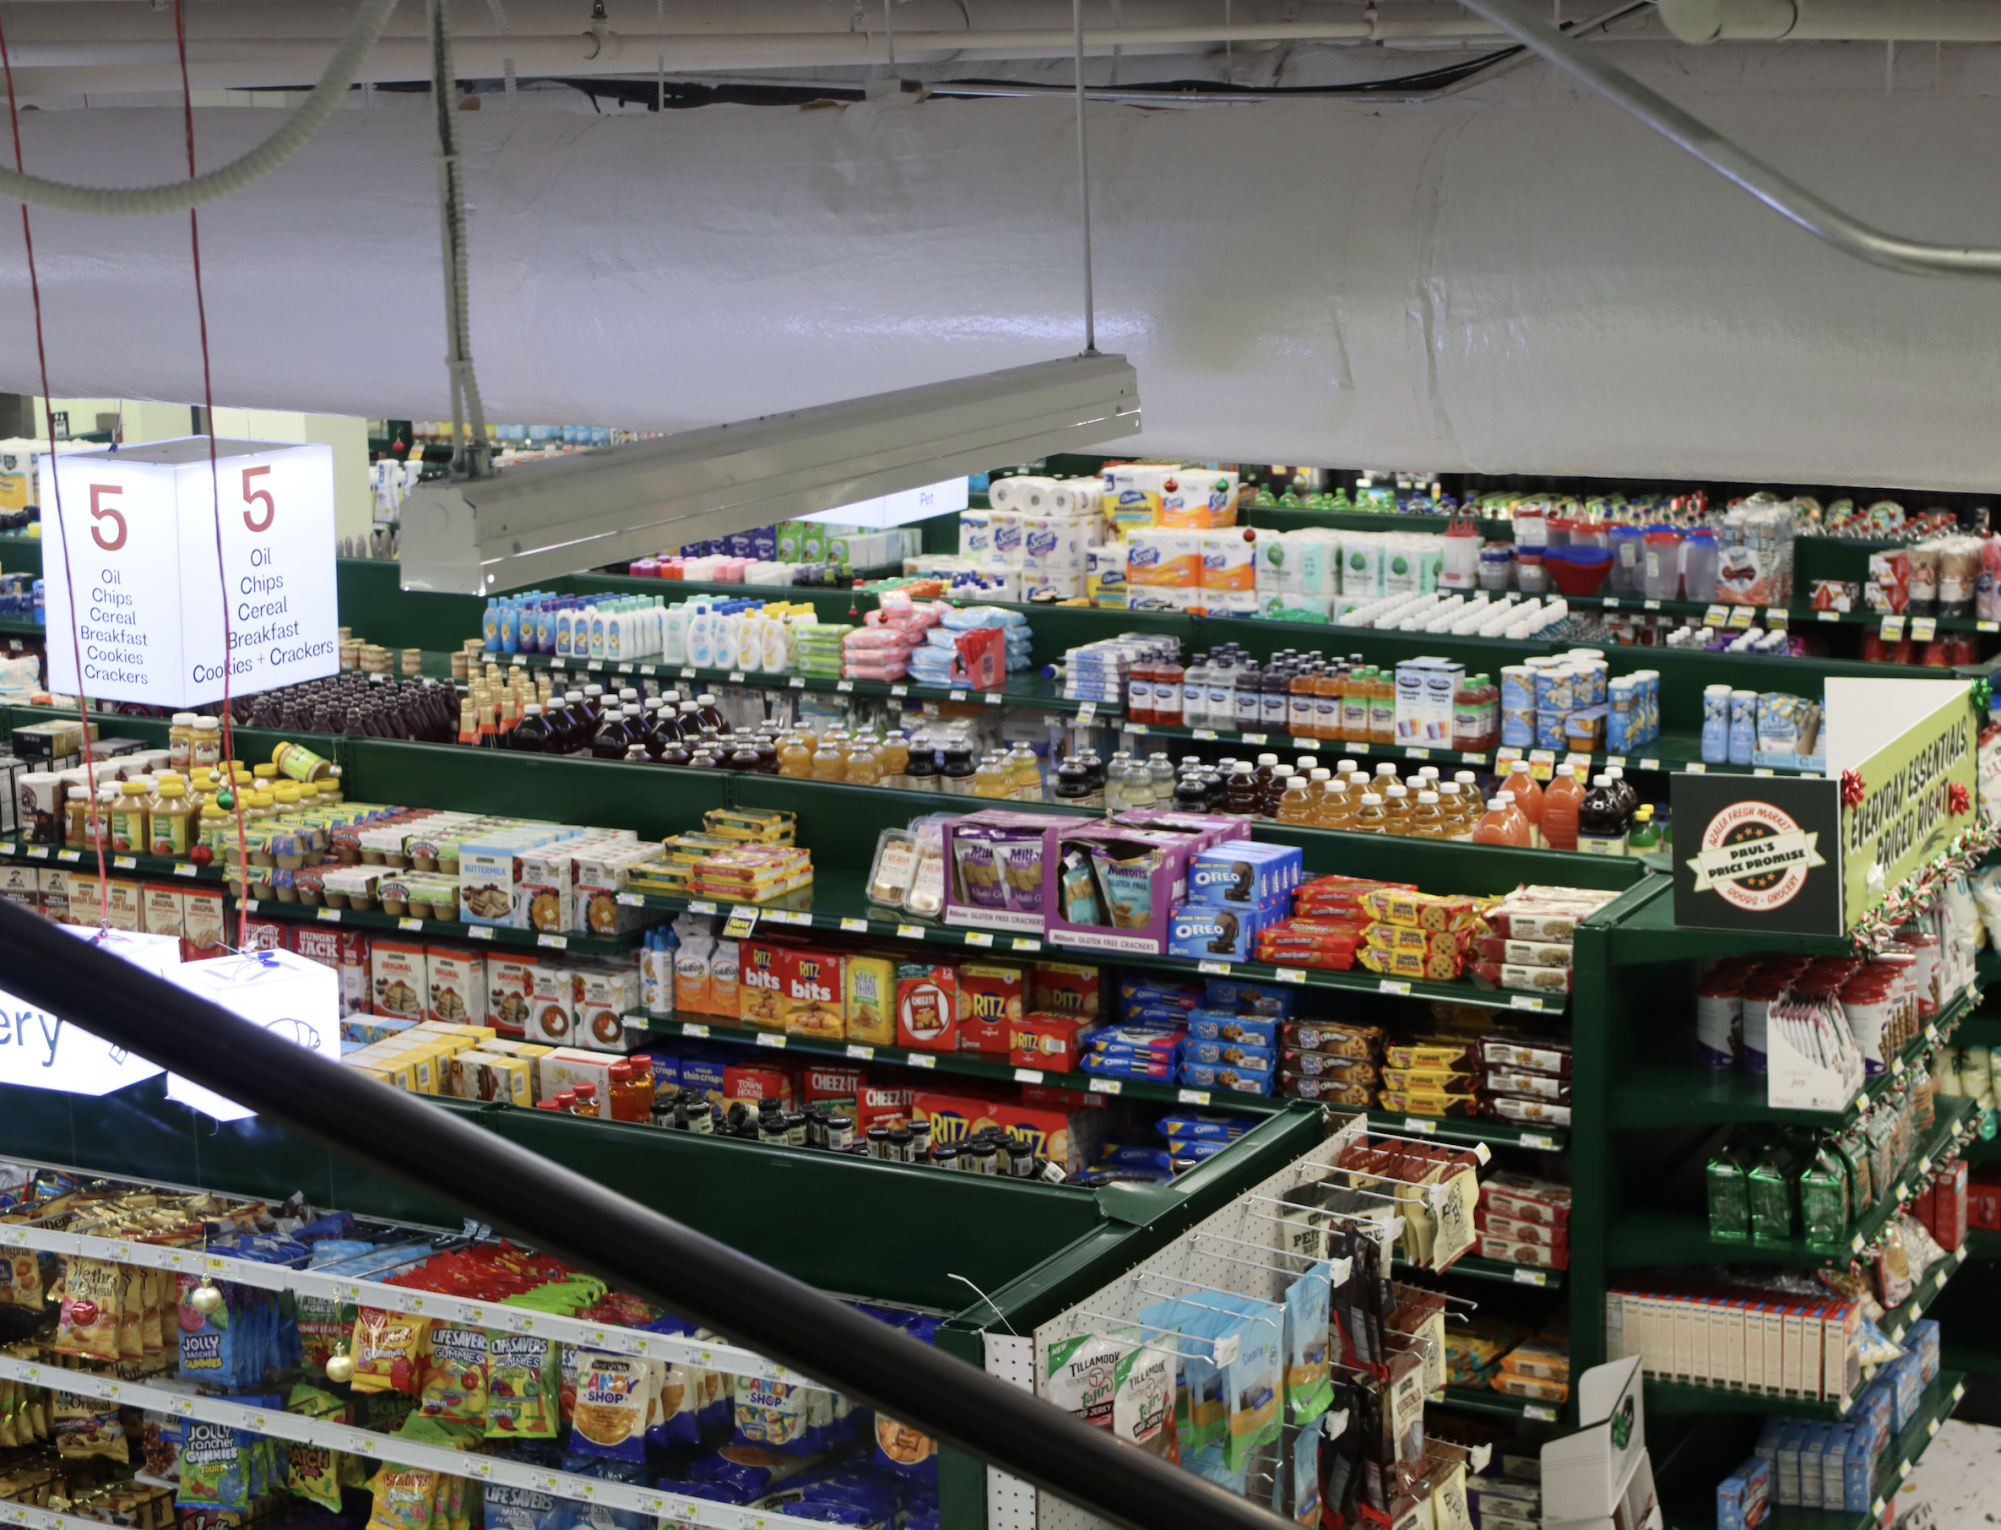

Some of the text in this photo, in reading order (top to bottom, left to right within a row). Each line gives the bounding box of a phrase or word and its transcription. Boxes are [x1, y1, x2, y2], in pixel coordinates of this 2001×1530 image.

[242, 465, 275, 532] 5
[920, 493, 934, 507] Pet
[89, 483, 128, 551] 5
[1114, 505, 1152, 513] essentials
[251, 548, 272, 567] Oil
[1132, 547, 1158, 566] Scott
[101, 569, 121, 586] Oil
[240, 574, 284, 596] Chips
[92, 588, 133, 608] Chips
[90, 607, 137, 626] Cereal
[238, 596, 288, 622] Cereal
[80, 625, 148, 647] Breakfast
[228, 620, 300, 650] Breakfast
[87, 645, 144, 666] Cookies
[192, 658, 253, 684] Cookies
[270, 640, 334, 666] Crackers
[84, 664, 148, 685] Crackers
[1851, 715, 1967, 852] EVERYDAY ESSENTIALS
[1708, 807, 1793, 847] AZALEA FRESH MARKET
[1877, 777, 1949, 869] PRICED RIGHT
[1730, 842, 1775, 860] PAUL'S
[464, 863, 507, 876] BUTTERMILK
[1708, 849, 1806, 879] PRICE PROMISE
[1194, 871, 1241, 886] OREO
[1727, 873, 1800, 906] GOODS GROCERY
[1393, 902, 1413, 911] CHIPS
[728, 917, 751, 929] New
[971, 911, 994, 922] GLUTEN
[995, 914, 1010, 922] FREE
[1011, 915, 1045, 926] CRACKERS
[299, 931, 337, 943] HUNGRY
[724, 926, 750, 937] Item!
[1175, 924, 1225, 939] OREO
[1400, 931, 1421, 939] CHIPS
[297, 940, 339, 958] JACK
[1078, 936, 1102, 946] GLUTEN
[1103, 938, 1118, 948] FREE
[1120, 940, 1155, 952] CRACKERS
[753, 948, 772, 967] RITZ
[1397, 953, 1418, 961] CHIPS
[381, 961, 412, 973] ORIGINAL
[434, 966, 460, 980] ORIGINAL
[675, 960, 705, 973] Goldfish
[799, 960, 820, 979] RITZ
[497, 971, 525, 984] ORIGINA
[745, 967, 781, 991] bits
[854, 971, 877, 983] WHEAT
[791, 979, 831, 1002] bits
[855, 981, 877, 998] THINS
[973, 992, 1006, 1018] RITZ
[1018, 1031, 1039, 1050] RITZ
[1109, 1043, 1132, 1053] OREO
[1104, 1057, 1129, 1066] OREO
[655, 1065, 677, 1076] crisps
[683, 1070, 700, 1080] thin
[737, 1079, 763, 1091] TOWN
[1792, 1079, 1805, 1088] joy
[737, 1088, 764, 1100] HOUSE
[873, 1112, 903, 1122] ORIGINAL
[930, 1111, 970, 1149] RITZ
[1194, 1124, 1220, 1134] OREO
[1005, 1124, 1047, 1158] RITZ
[303, 1304, 335, 1313] FOREST
[320, 1325, 341, 1334] BEARS
[432, 1328, 454, 1346] LIFE
[182, 1334, 221, 1351] JOLLY
[491, 1337, 548, 1355] LIFE SAVERS
[1051, 1341, 1068, 1357] NEW
[186, 1349, 217, 1358] RANCHER
[434, 1347, 485, 1365] GUMMIES
[184, 1358, 222, 1369] GUMMIES
[495, 1356, 541, 1369] GUMMIES
[577, 1371, 641, 1394] CANDY
[737, 1374, 798, 1399] CANDY
[587, 1390, 624, 1404] SHOP
[750, 1391, 783, 1407] SHOP
[70, 1397, 111, 1414] Original
[1089, 1403, 1112, 1416] JERKY
[188, 1424, 233, 1441] JOLLY
[190, 1438, 235, 1450] rancher
[185, 1448, 238, 1463] GUMMIES
[486, 1486, 554, 1512] LIFE SAVERS
[501, 1508, 531, 1520] MINTS
